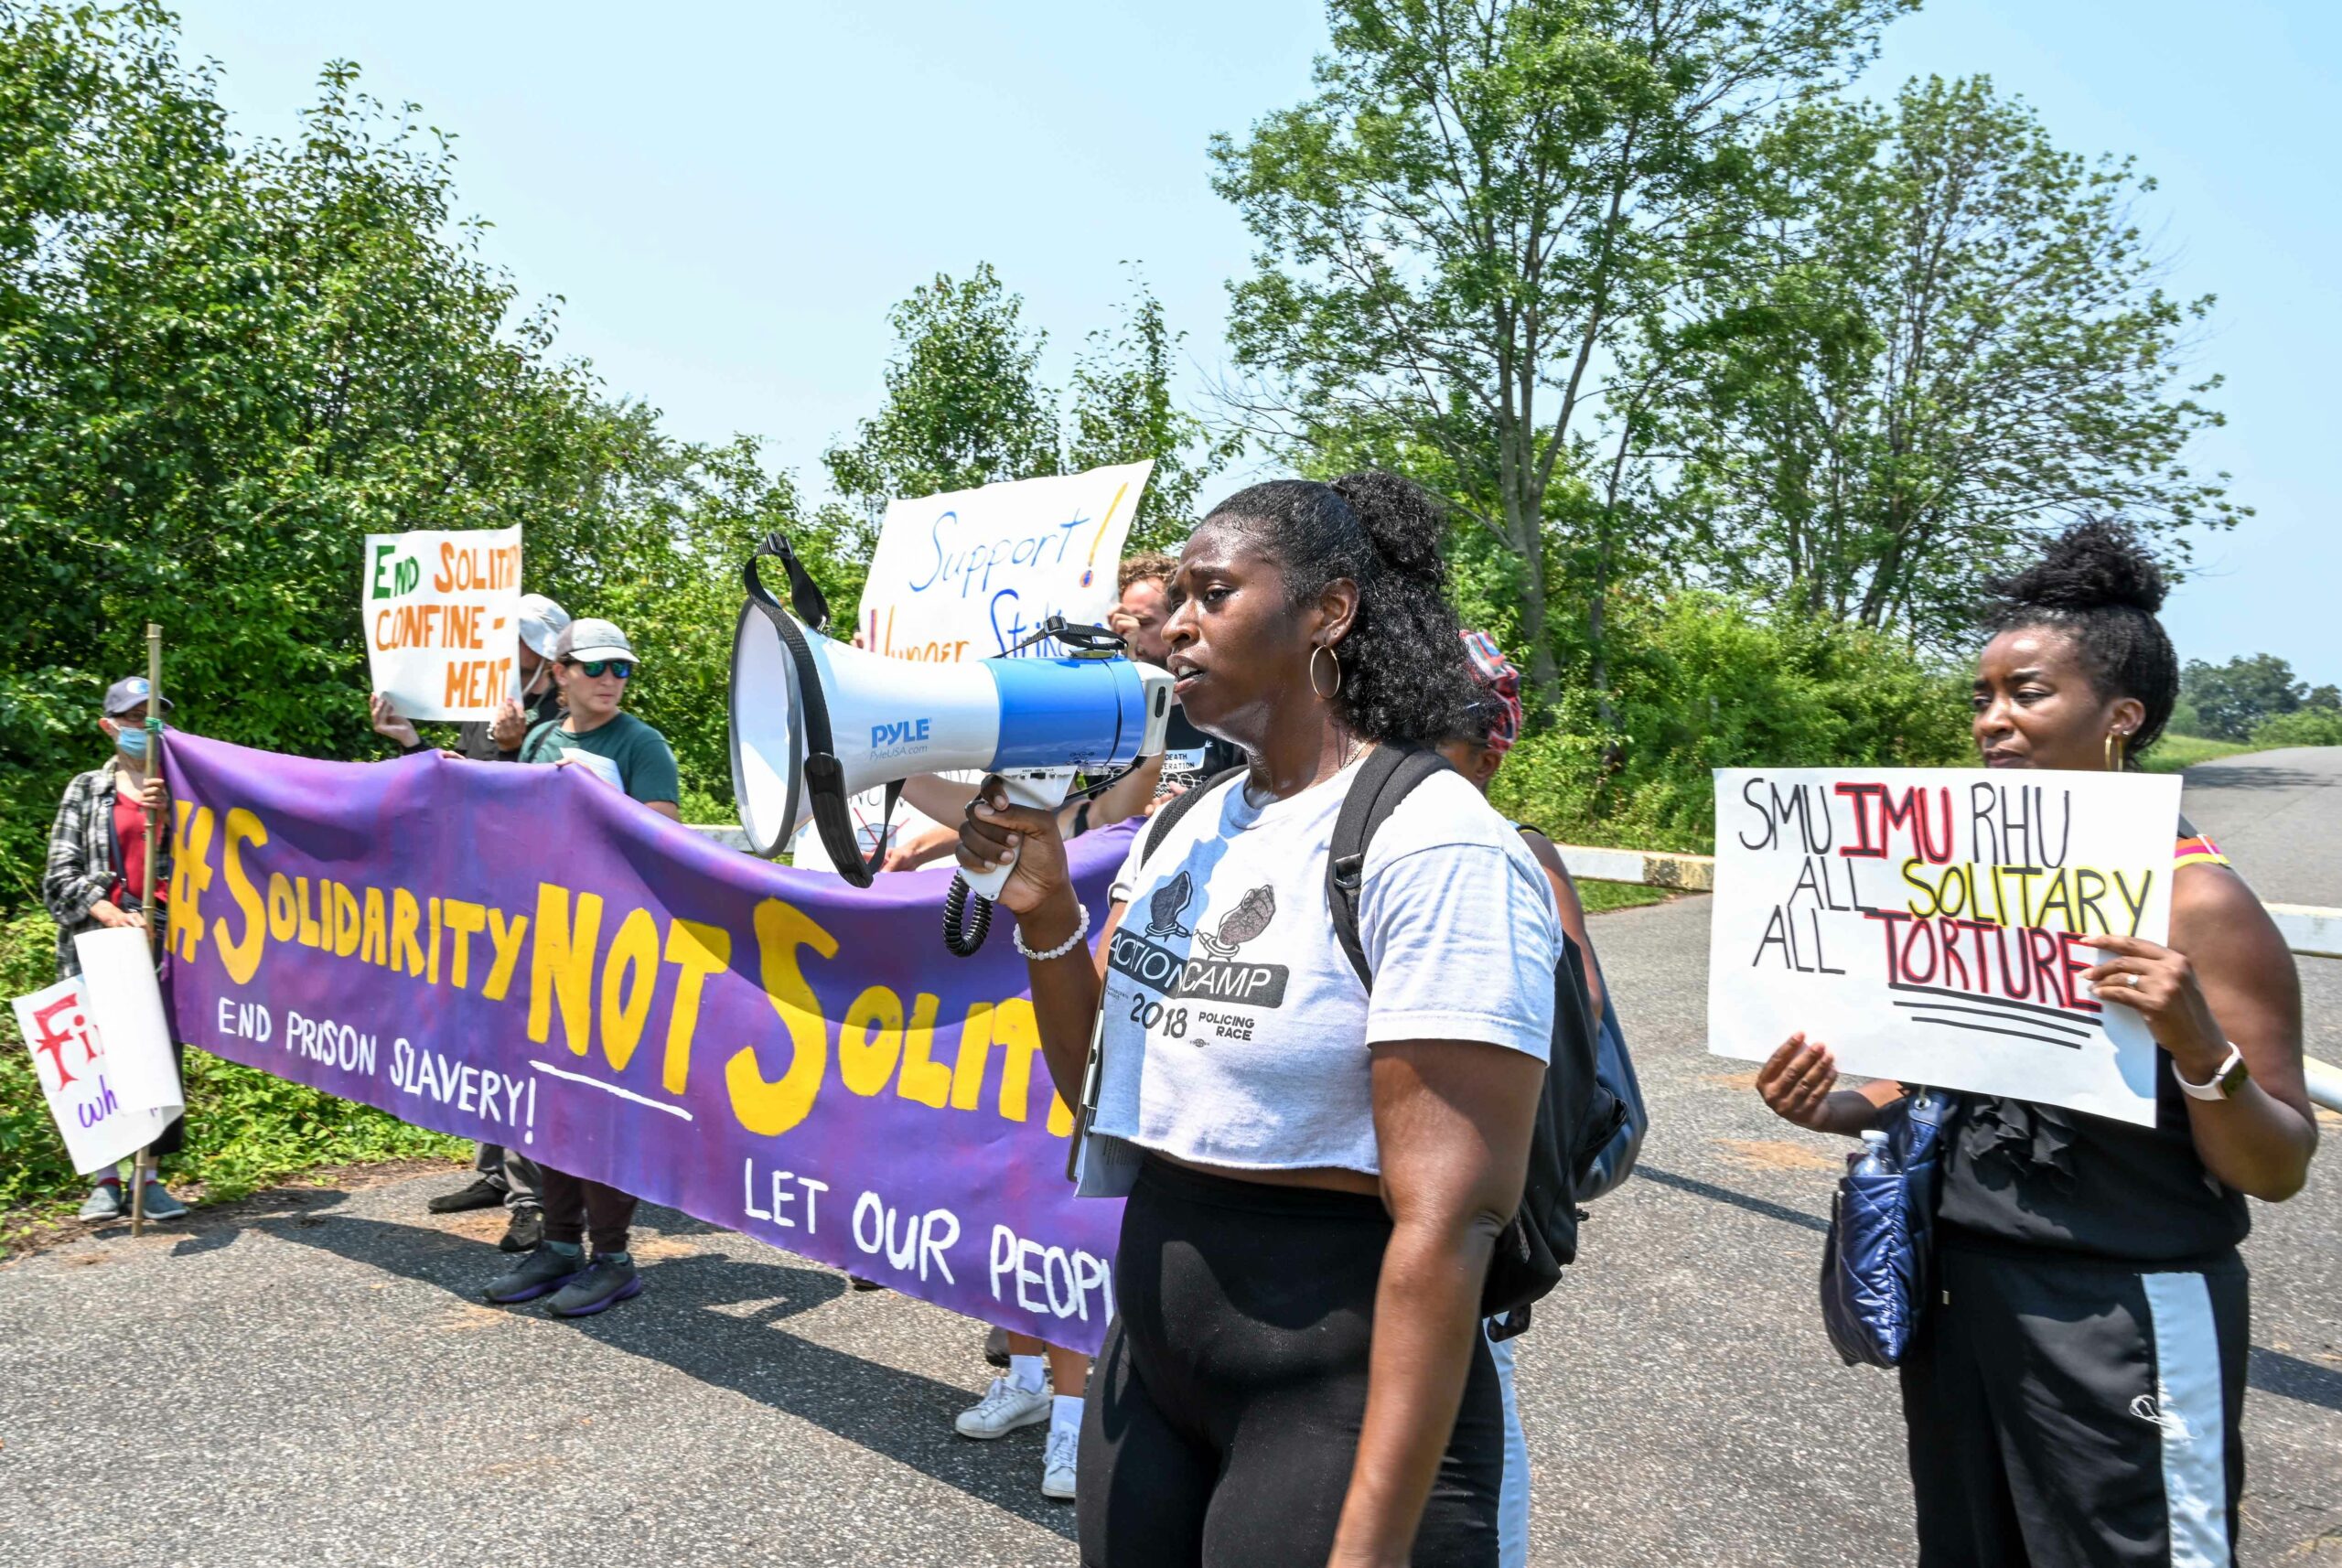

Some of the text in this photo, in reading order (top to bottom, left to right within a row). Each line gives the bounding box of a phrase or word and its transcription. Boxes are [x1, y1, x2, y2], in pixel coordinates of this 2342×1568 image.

[371, 544, 420, 600] END
[444, 657, 511, 708] MENT
[869, 746, 929, 761] PyleUSA.com
[871, 718, 929, 748] PYLE
[1739, 778, 2070, 868] SMU IMU RHU
[1788, 854, 2153, 938] ALL SOLITARY
[1182, 961, 1272, 998] CAMP
[1752, 904, 2103, 1013] ALL TORTURE
[527, 881, 731, 1096] NOT
[725, 897, 1075, 1138] SOLIT
[1130, 992, 1188, 1038] 2018
[1198, 1011, 1255, 1029] POLICING
[1216, 1026, 1252, 1041] RACE
[33, 993, 104, 1091] Fi
[219, 996, 536, 1144] END PRISON SLAVERY!
[745, 1157, 829, 1234] LET
[852, 1191, 960, 1285] OUR
